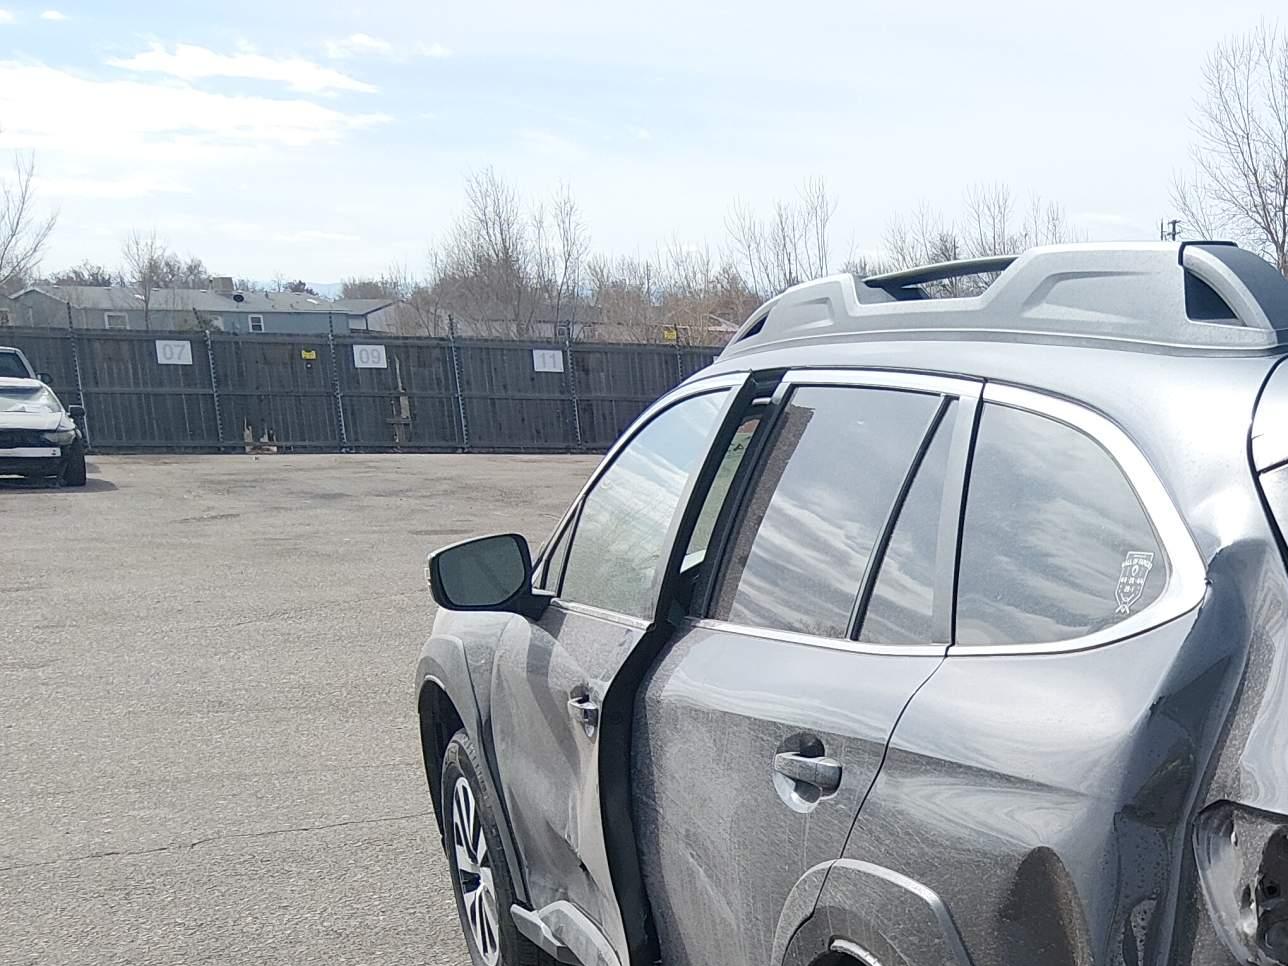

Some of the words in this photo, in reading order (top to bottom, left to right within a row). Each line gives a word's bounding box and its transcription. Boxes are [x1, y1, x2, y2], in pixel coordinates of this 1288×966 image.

[161, 343, 186, 361] 07
[358, 348, 382, 365] 09
[539, 350, 558, 369] 11
